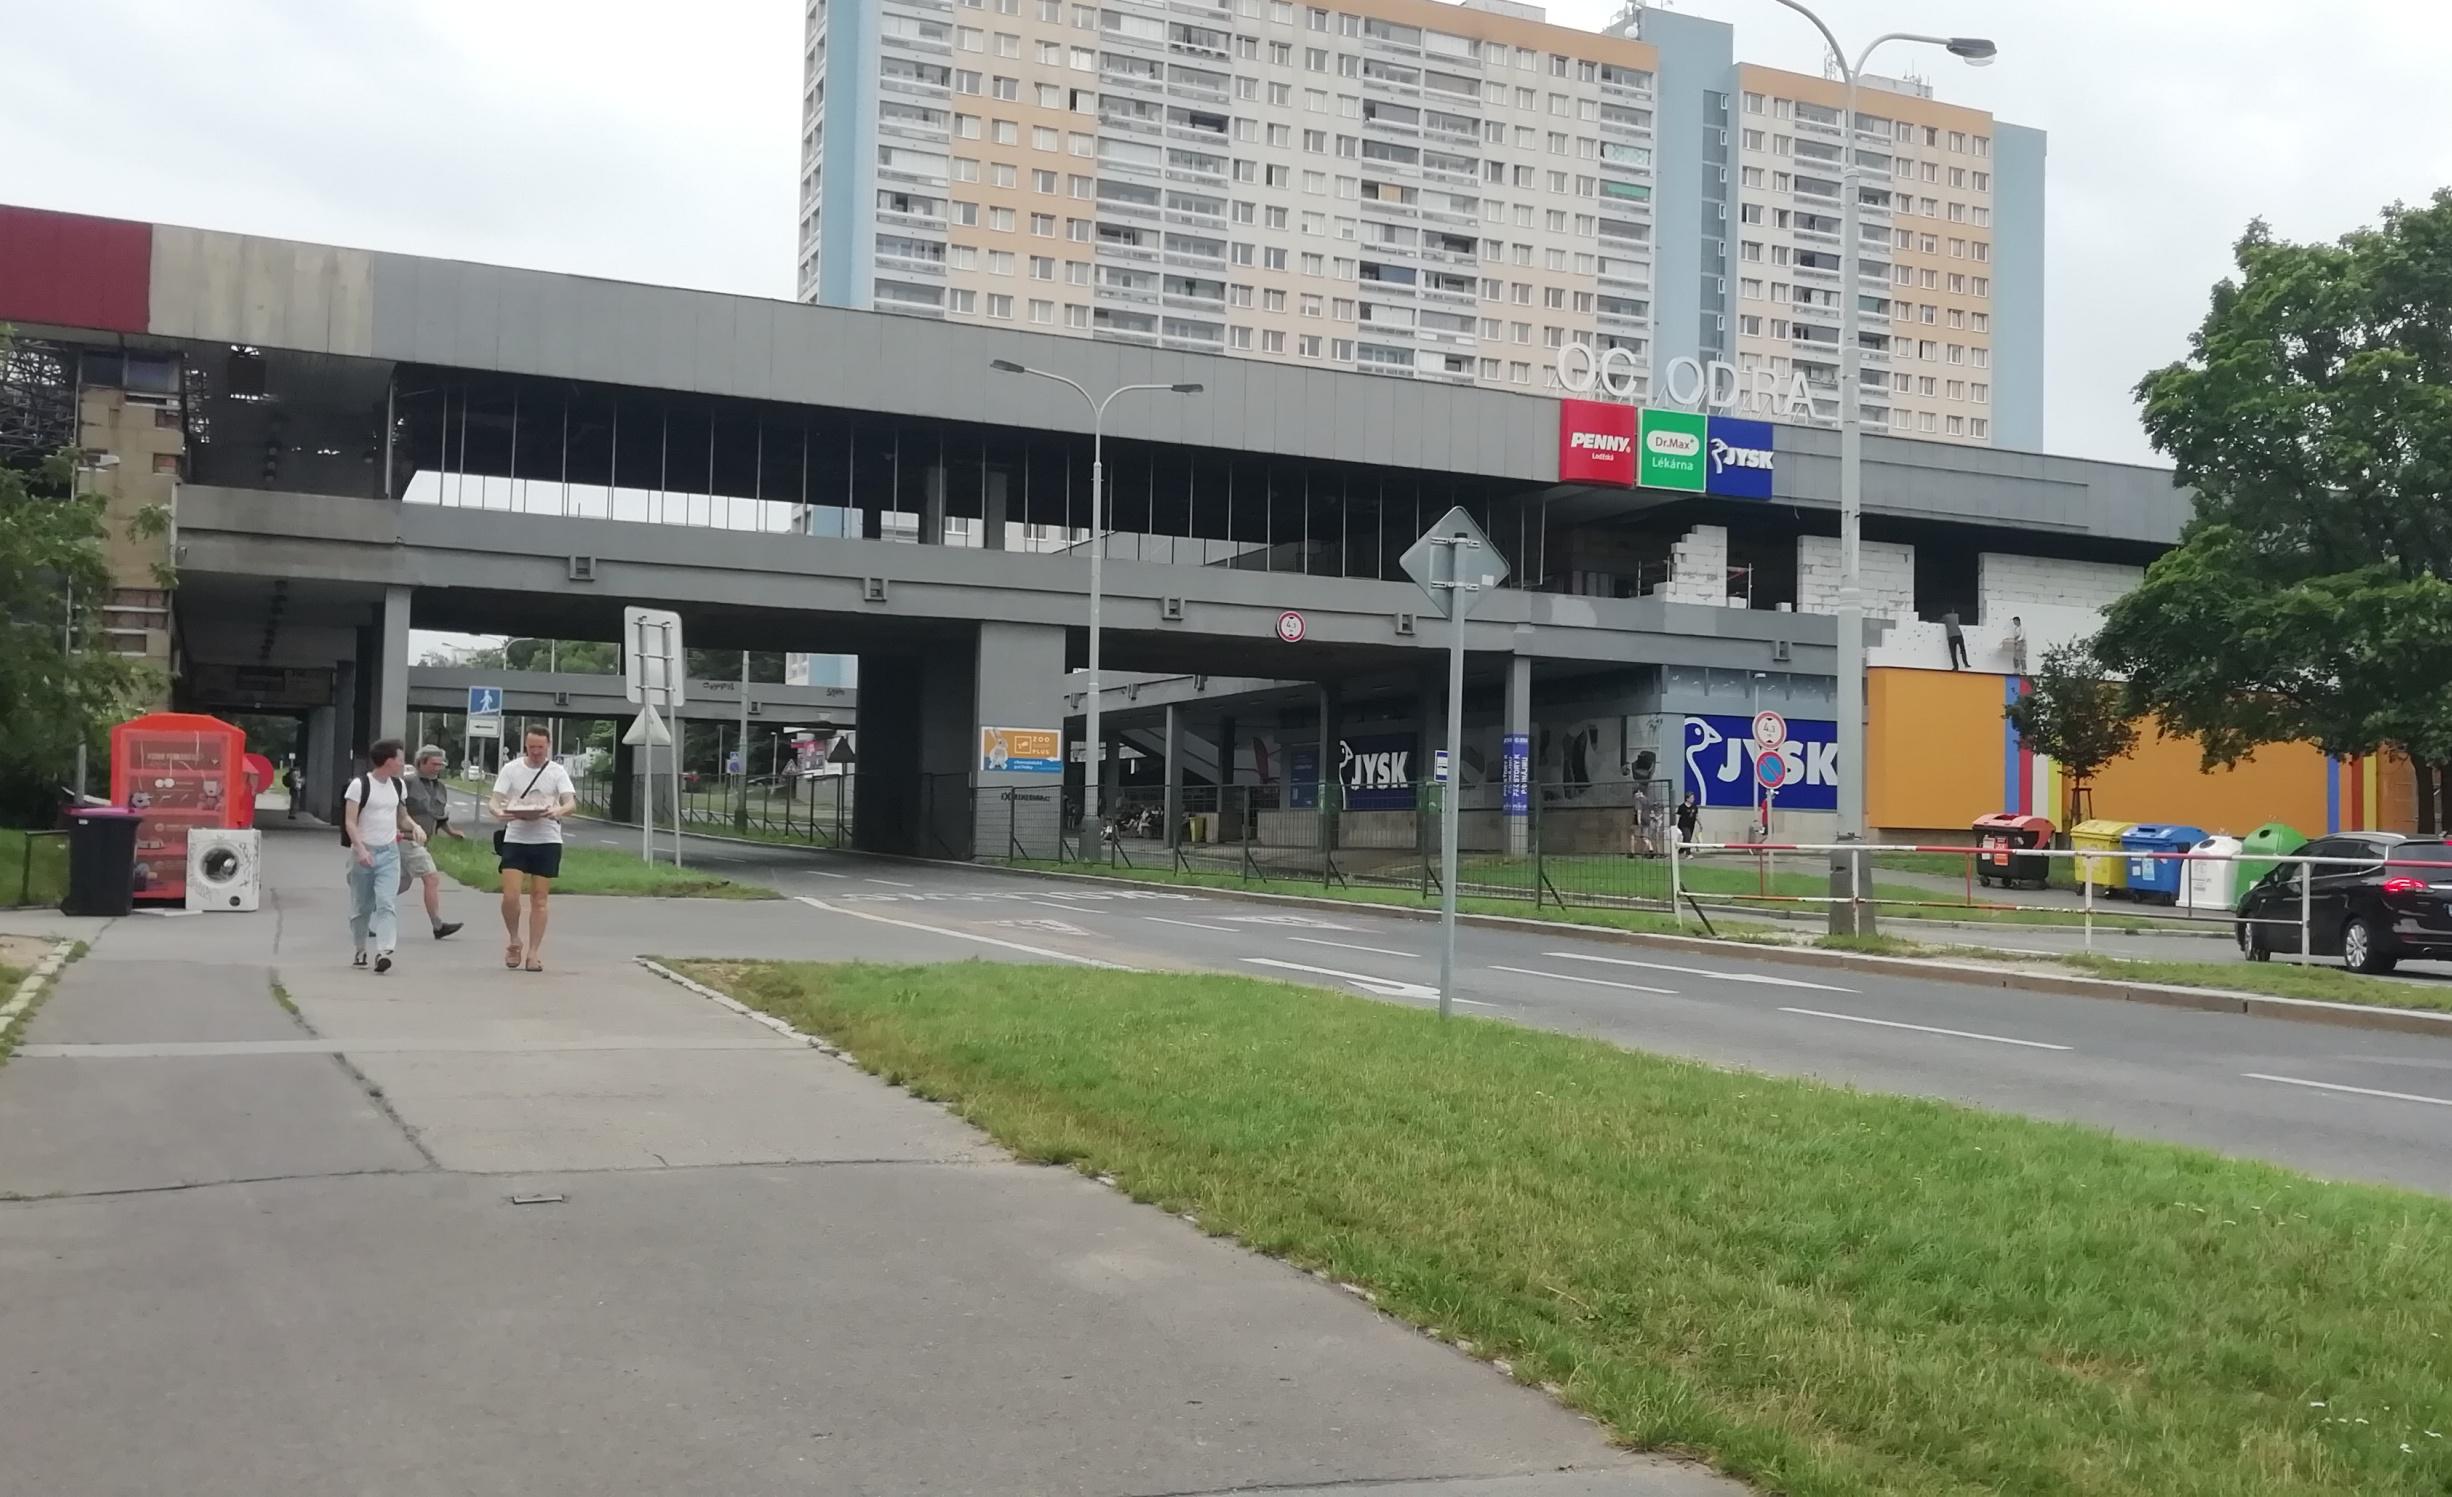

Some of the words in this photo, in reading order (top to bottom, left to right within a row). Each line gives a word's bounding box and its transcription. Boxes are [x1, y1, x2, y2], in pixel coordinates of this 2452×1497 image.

[1557, 342, 1638, 398] OC
[1665, 356, 1817, 419] ODRA
[1652, 456, 1694, 471] Lékárna
[1723, 447, 1774, 470] JYSK
[1351, 751, 1409, 790] JYSK
